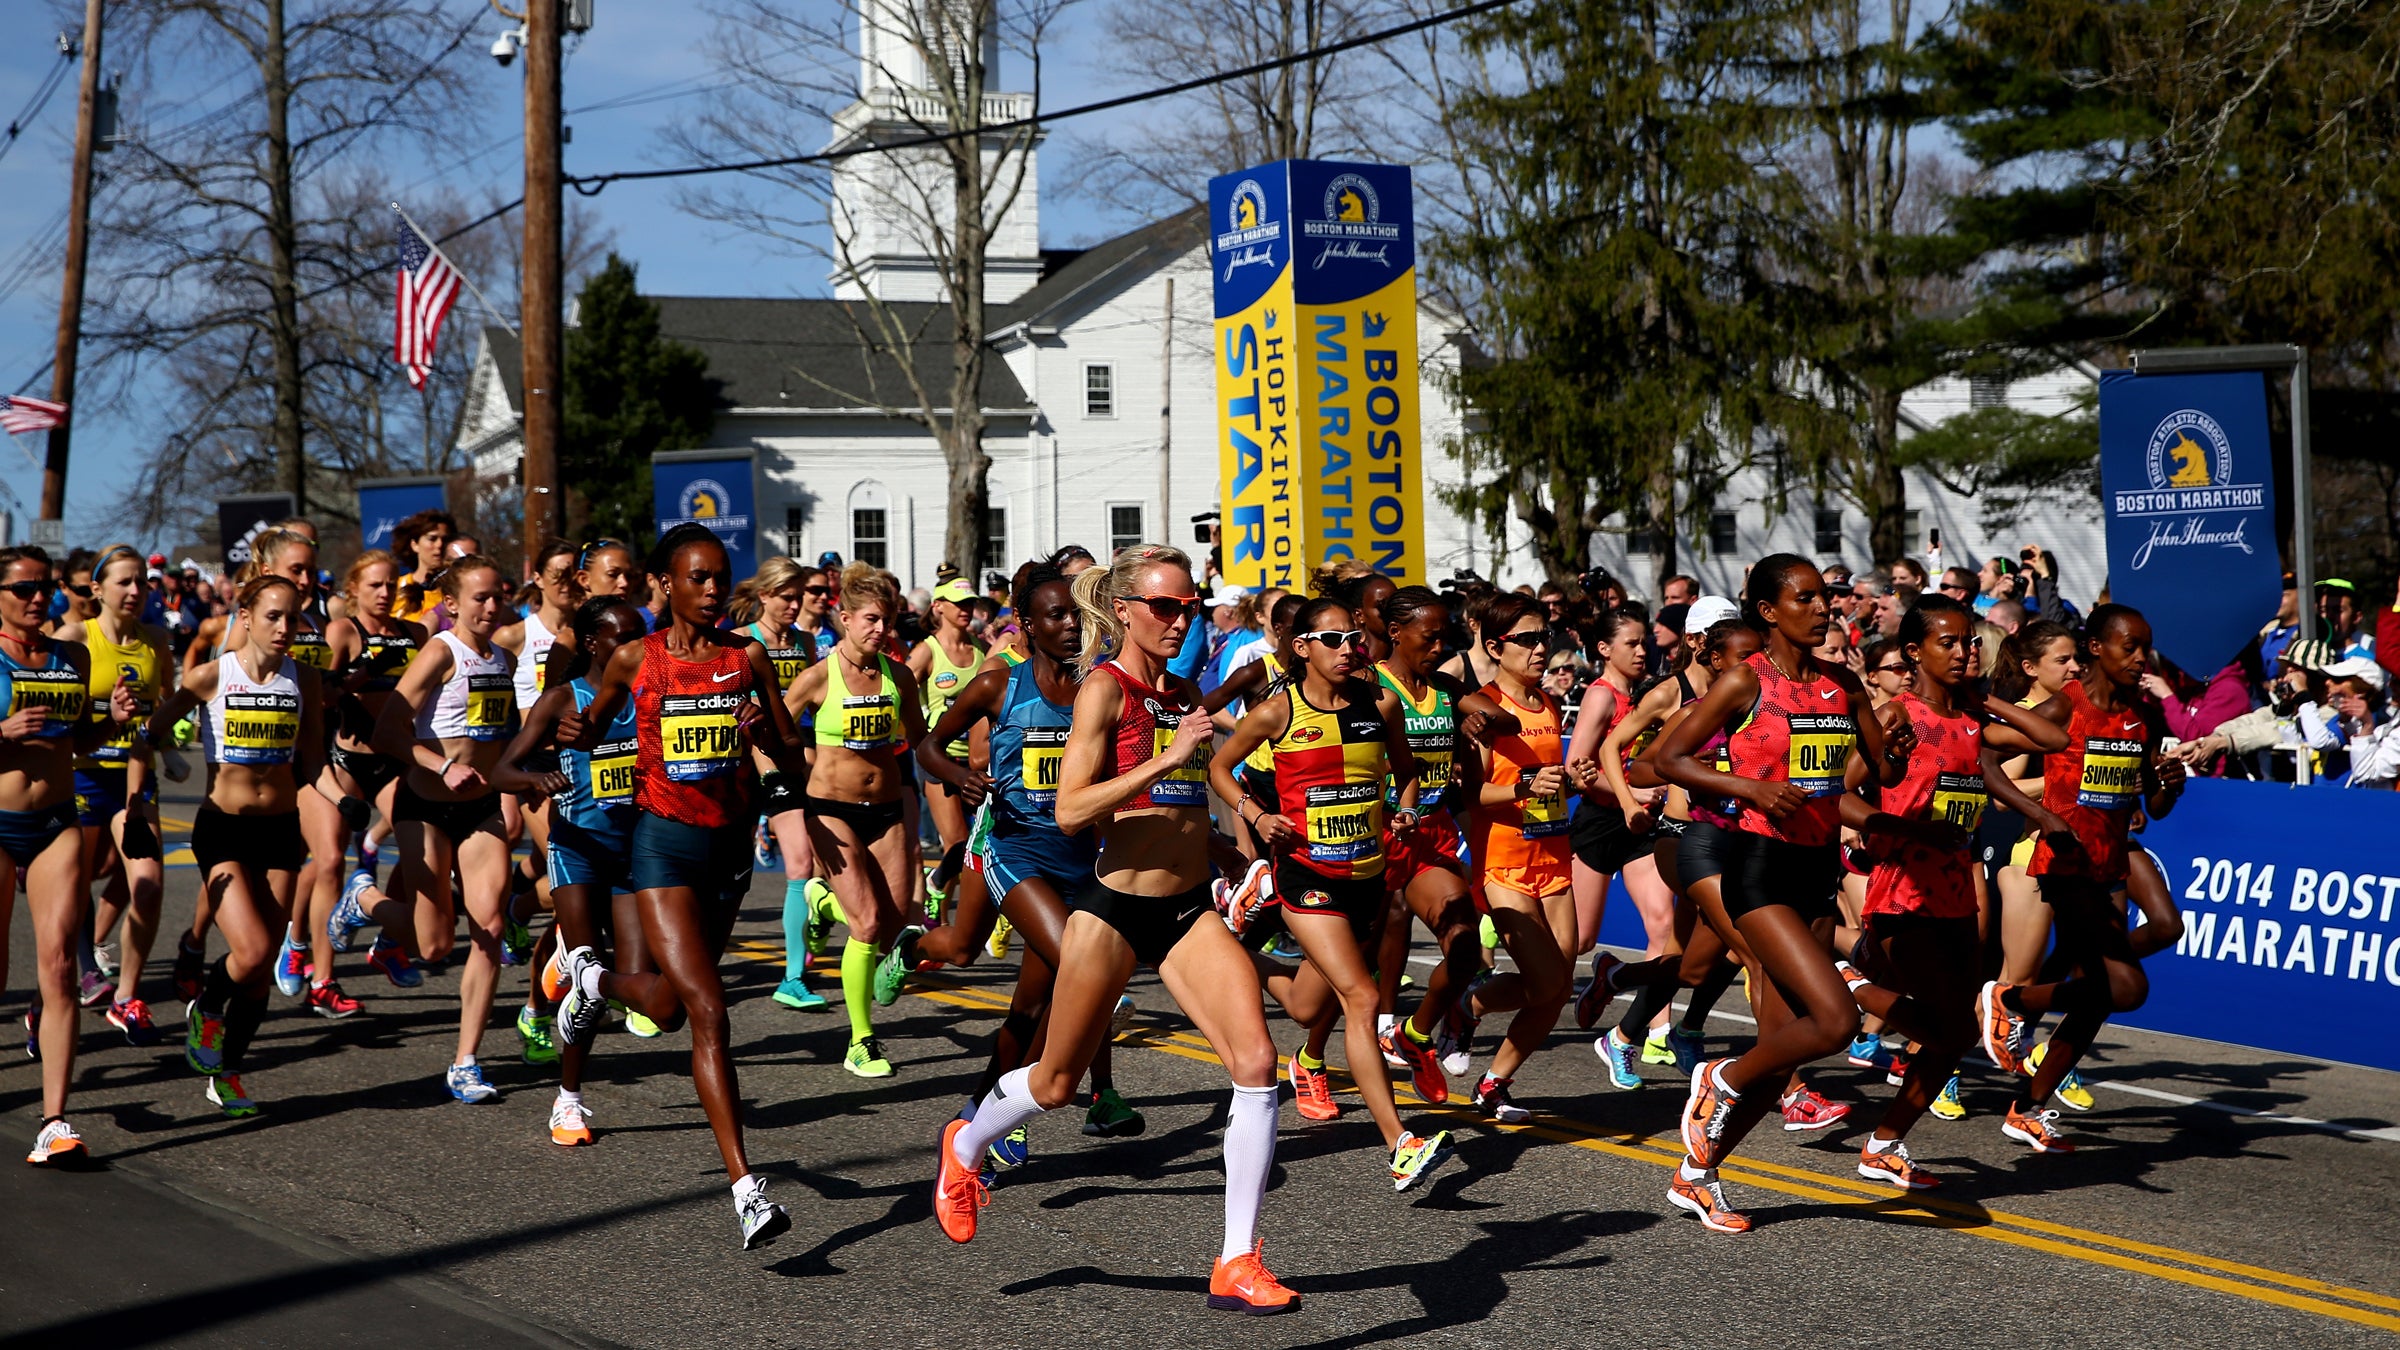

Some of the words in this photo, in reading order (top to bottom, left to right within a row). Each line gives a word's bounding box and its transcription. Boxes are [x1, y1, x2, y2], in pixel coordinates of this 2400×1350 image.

[1218, 233, 1243, 249] BOSTON
[1243, 225, 1280, 242] MARATHON
[1304, 223, 1342, 235] BOSTON
[1345, 225, 1398, 237] MARATHON
[1312, 240, 1345, 270] John
[1344, 240, 1391, 268] Hancock
[2150, 440, 2163, 484] BOSTON
[2157, 413, 2197, 441] ATHLETIC
[2197, 416, 2229, 480] ASSOCIATION
[1265, 336, 1292, 588] HOPKINTON
[1363, 349, 1406, 578] BOSTON
[2115, 492, 2176, 513] BOSTON
[2181, 488, 2262, 510] MARATHON
[2131, 519, 2180, 571] John
[2178, 516, 2254, 556] Hancock
[302, 647, 322, 666] 42
[15, 691, 84, 717] THOMAS
[226, 721, 297, 740] CUMMINGS
[850, 713, 893, 737] PIERS
[1405, 716, 1454, 731] THIOPIA
[1520, 728, 1543, 737] okyo
[1816, 715, 1852, 729] adidas
[672, 725, 741, 754] JEPTOO
[1424, 735, 1454, 747] adidas
[2110, 740, 2143, 753] adidas
[1038, 756, 1062, 785] KI
[1959, 776, 1985, 789] adidas
[2083, 764, 2138, 787] SUMGON
[1339, 786, 1377, 799] adidas
[1317, 809, 1372, 840] LINDEN
[2184, 856, 2275, 908] 2014
[2289, 867, 2400, 923] BOST
